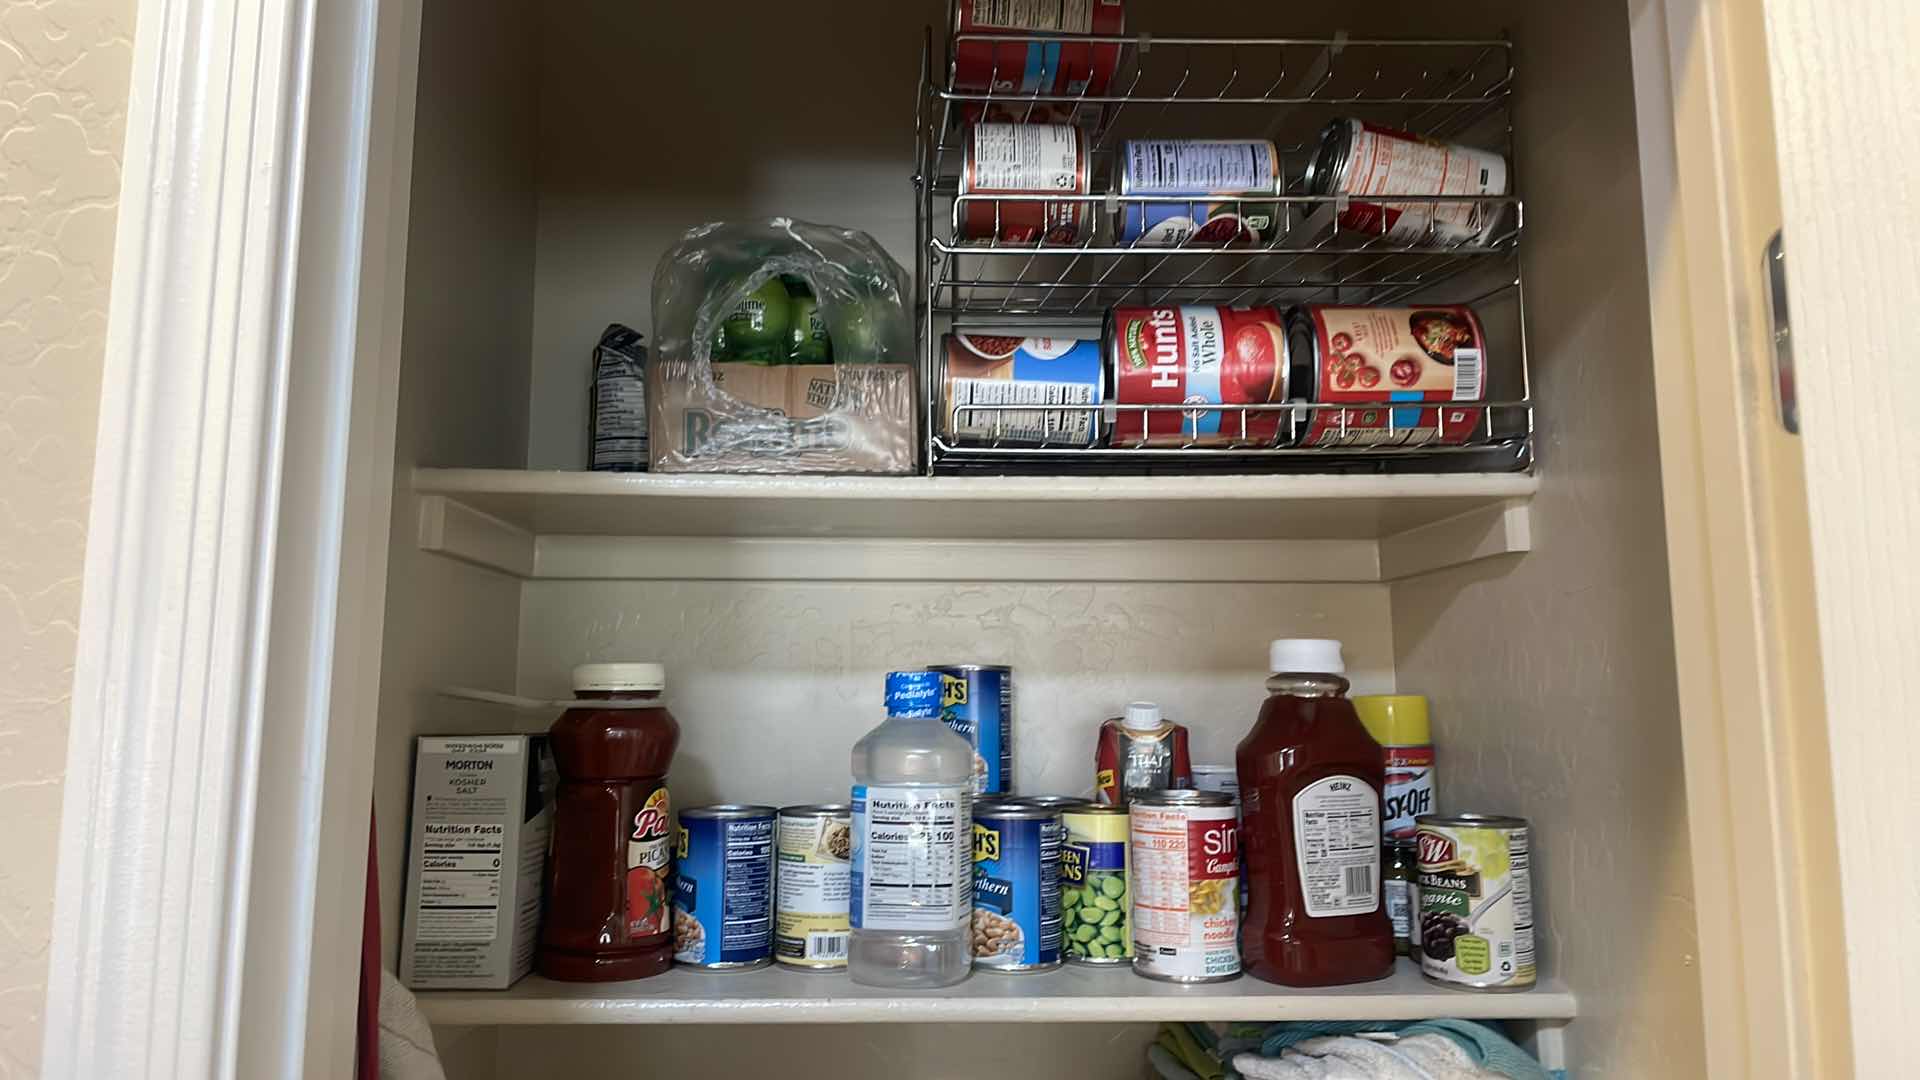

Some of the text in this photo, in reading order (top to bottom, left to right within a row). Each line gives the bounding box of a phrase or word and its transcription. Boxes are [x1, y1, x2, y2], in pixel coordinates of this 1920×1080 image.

[1189, 316, 1200, 373] No Salt Added
[1200, 320, 1216, 365] Whole
[446, 760, 493, 770] MORTON
[456, 786, 478, 794] SALT
[1329, 782, 1352, 792] HEINZ
[924, 801, 955, 809] Facts
[425, 824, 502, 834] Nutrition Facts
[871, 831, 909, 840] Calories
[936, 831, 954, 841] 100
[423, 858, 500, 868] Calories 0
[1430, 874, 1467, 890] BEANS
